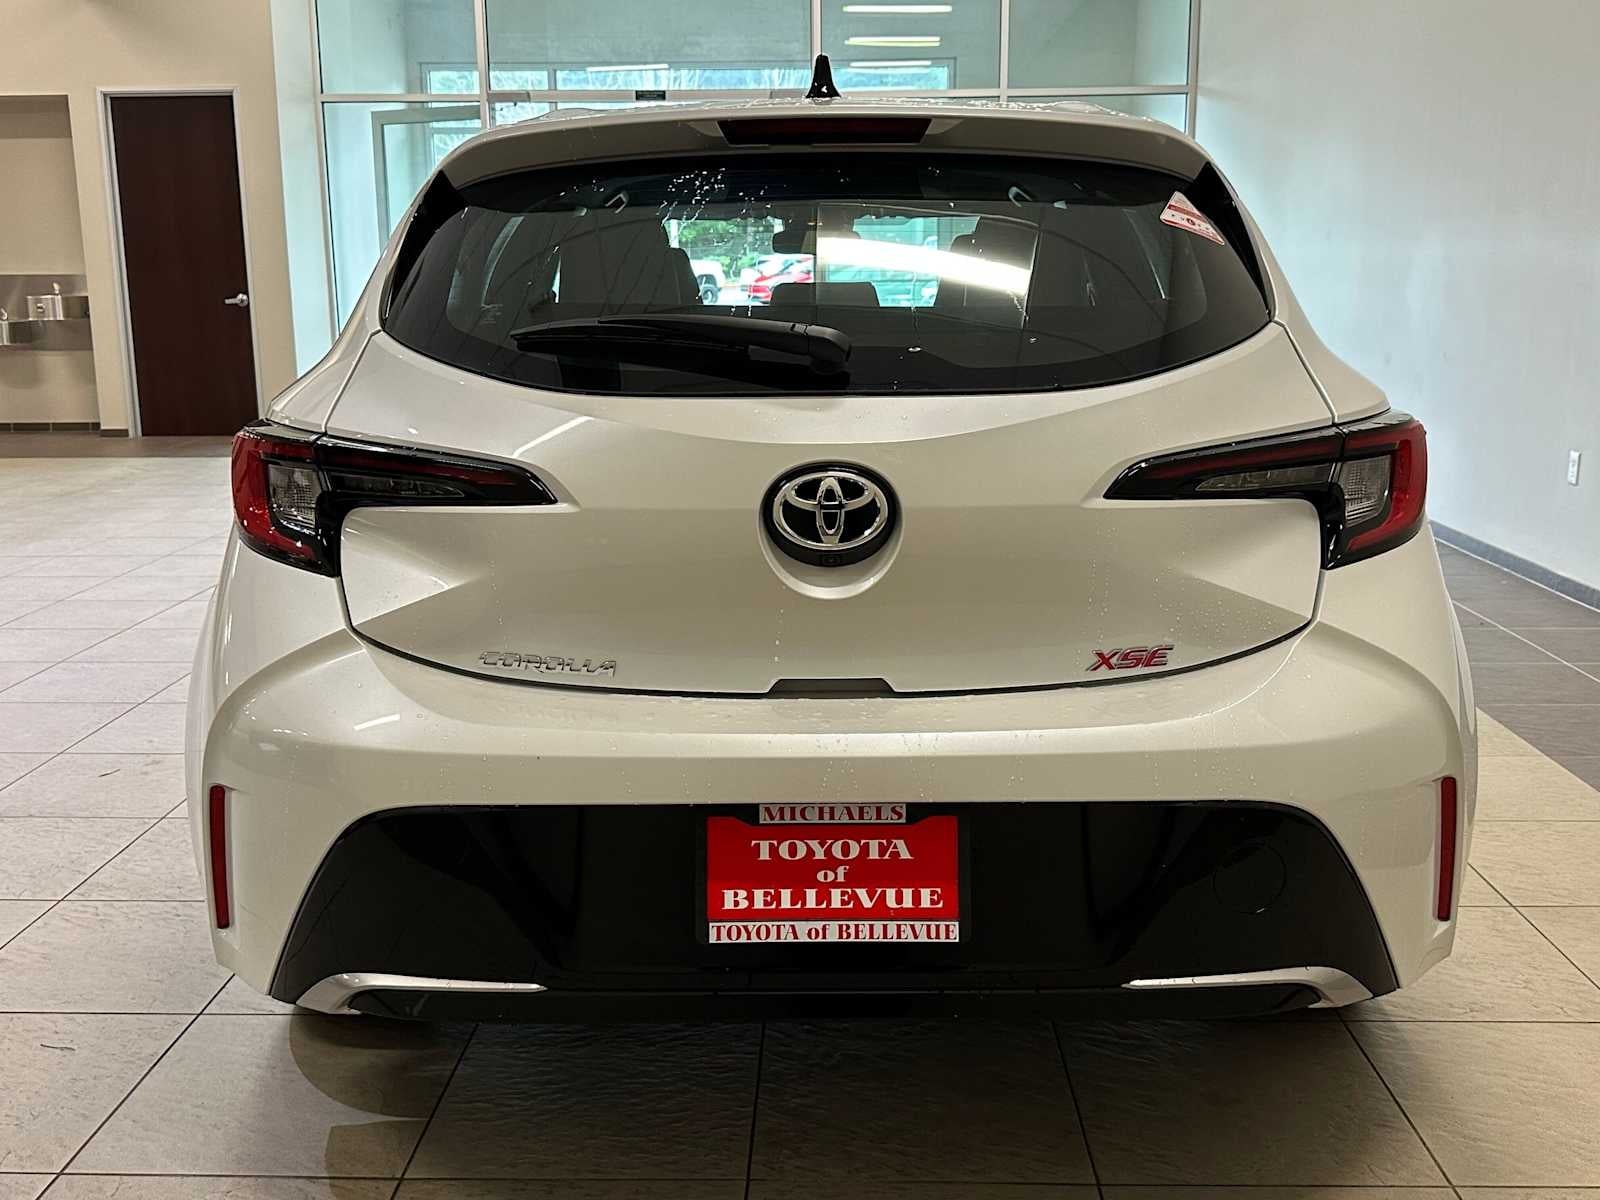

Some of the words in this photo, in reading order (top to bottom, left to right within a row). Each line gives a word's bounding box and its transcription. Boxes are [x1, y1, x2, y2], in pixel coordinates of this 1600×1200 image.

[479, 651, 616, 678] COROLLA
[1086, 645, 1174, 671] XSE
[762, 804, 905, 821] MICHAELS
[751, 839, 914, 860] TOYOTA
[816, 865, 849, 883] of
[721, 887, 944, 910] BELLEVUE
[711, 924, 799, 942] TOYOTA
[806, 923, 830, 941] of
[837, 923, 957, 941] BELLEVUE
